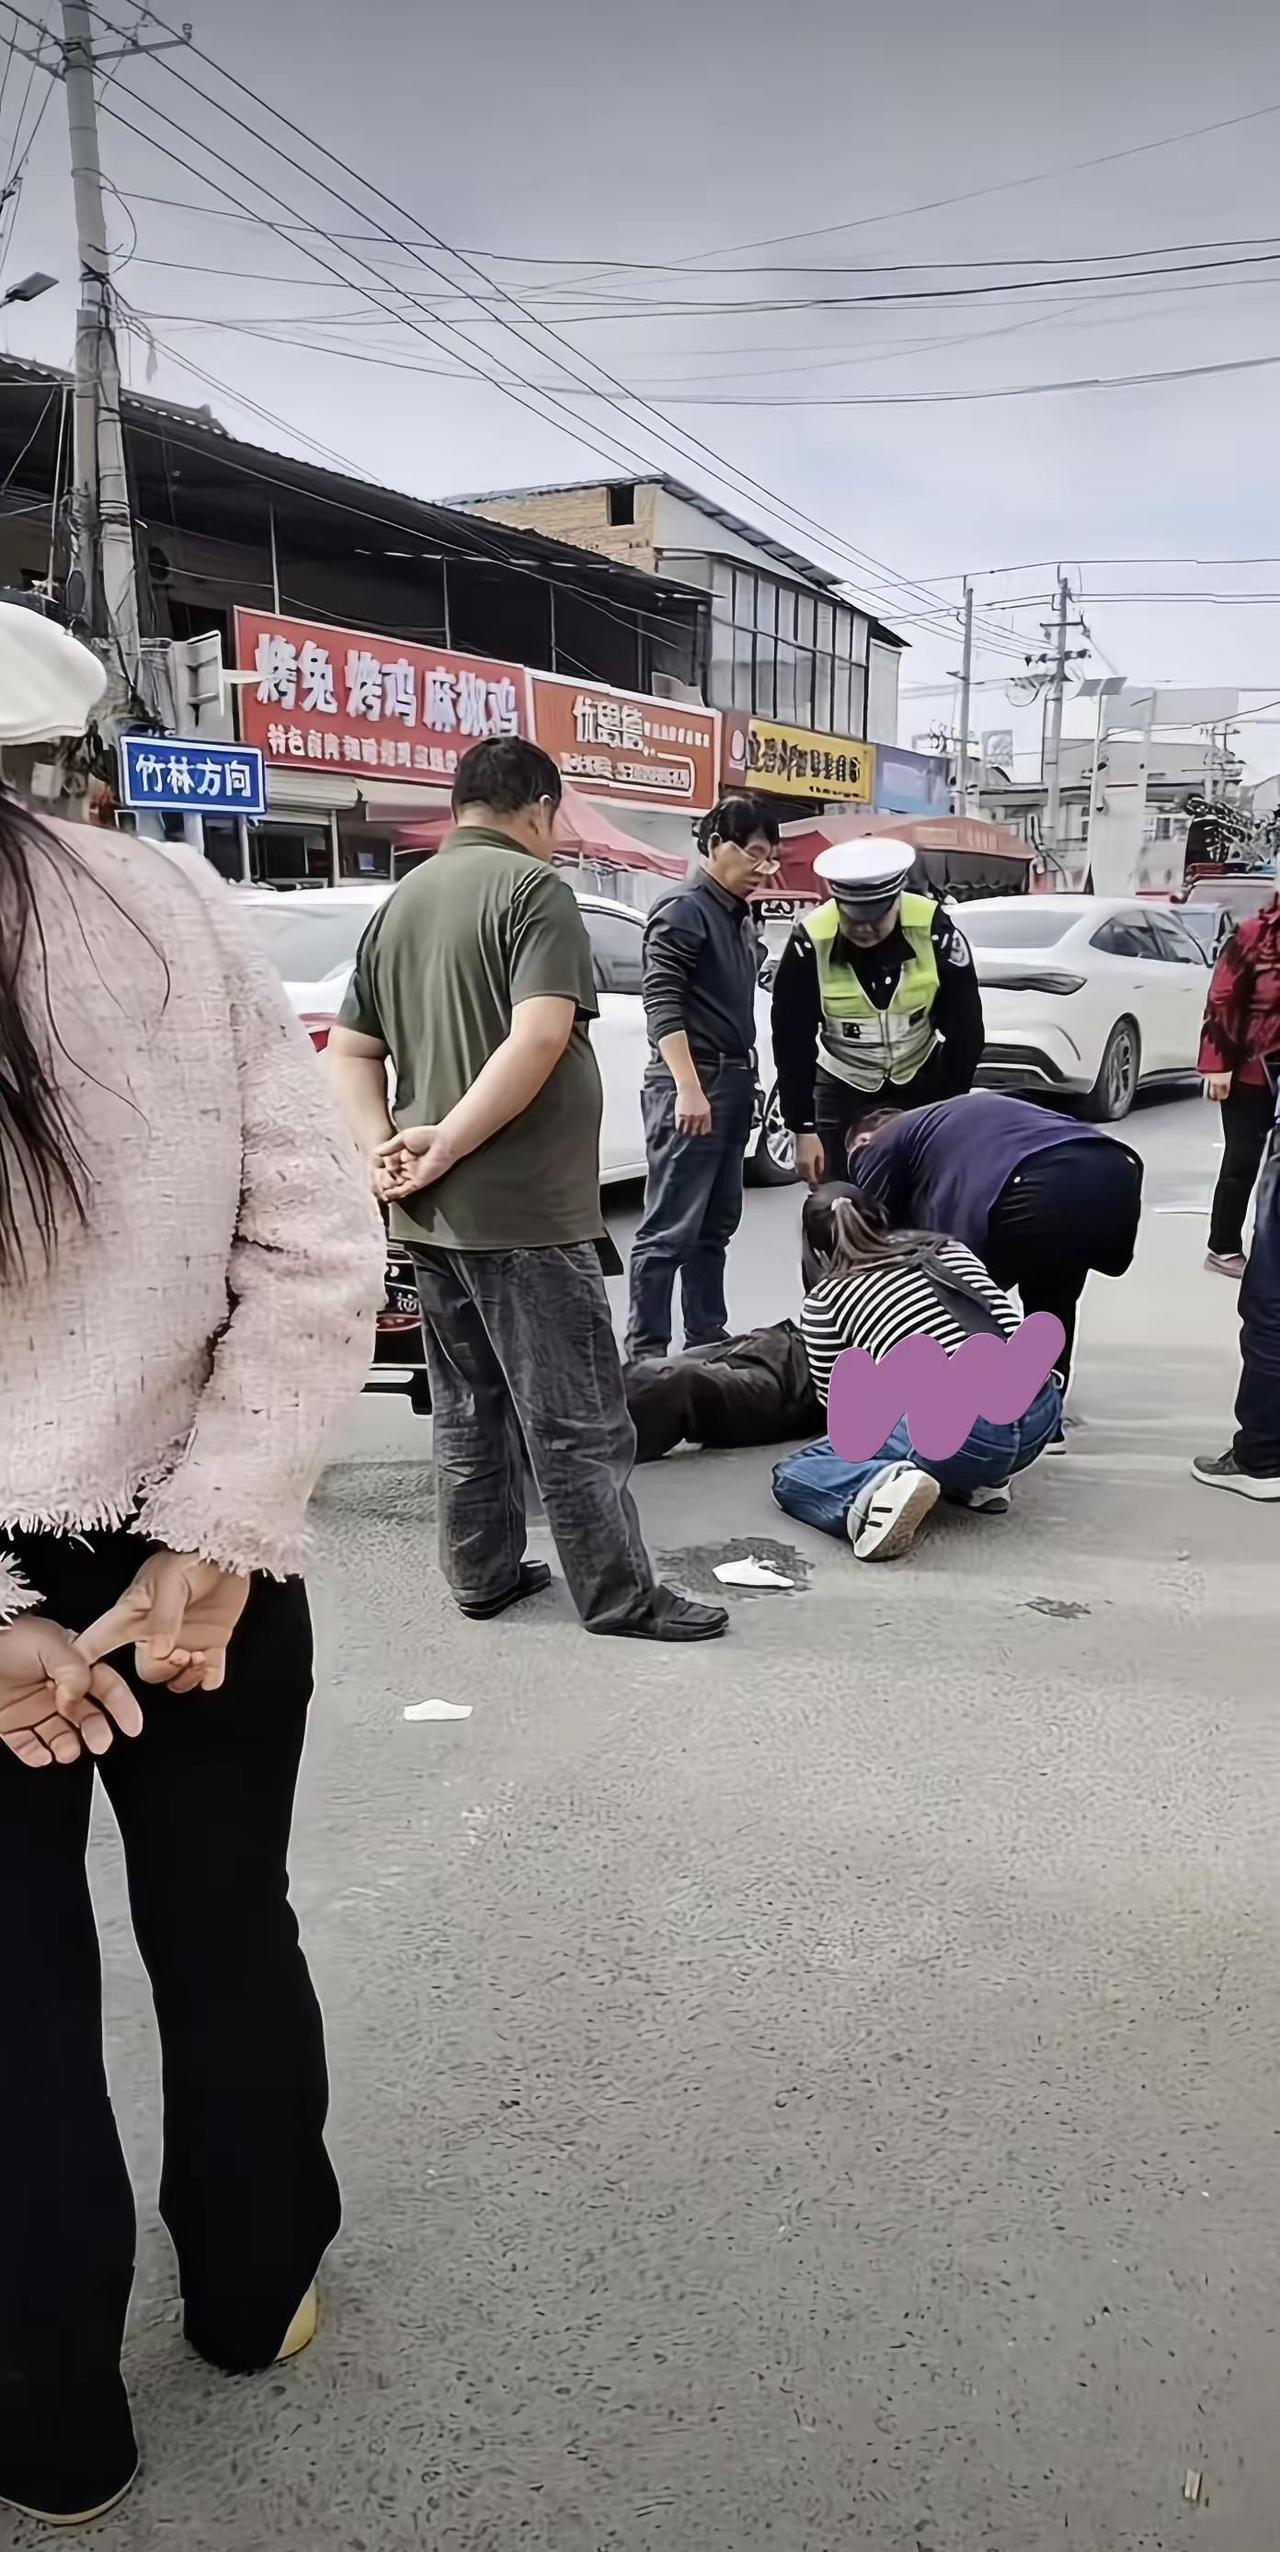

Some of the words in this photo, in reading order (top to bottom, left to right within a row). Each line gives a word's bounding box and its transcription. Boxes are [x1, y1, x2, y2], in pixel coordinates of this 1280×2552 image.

[255, 633, 337, 713] 烤兔
[344, 649, 417, 727] 烤鸡
[422, 665, 519, 738] 麻椒鸡
[135, 754, 251, 797] 竹林方向
